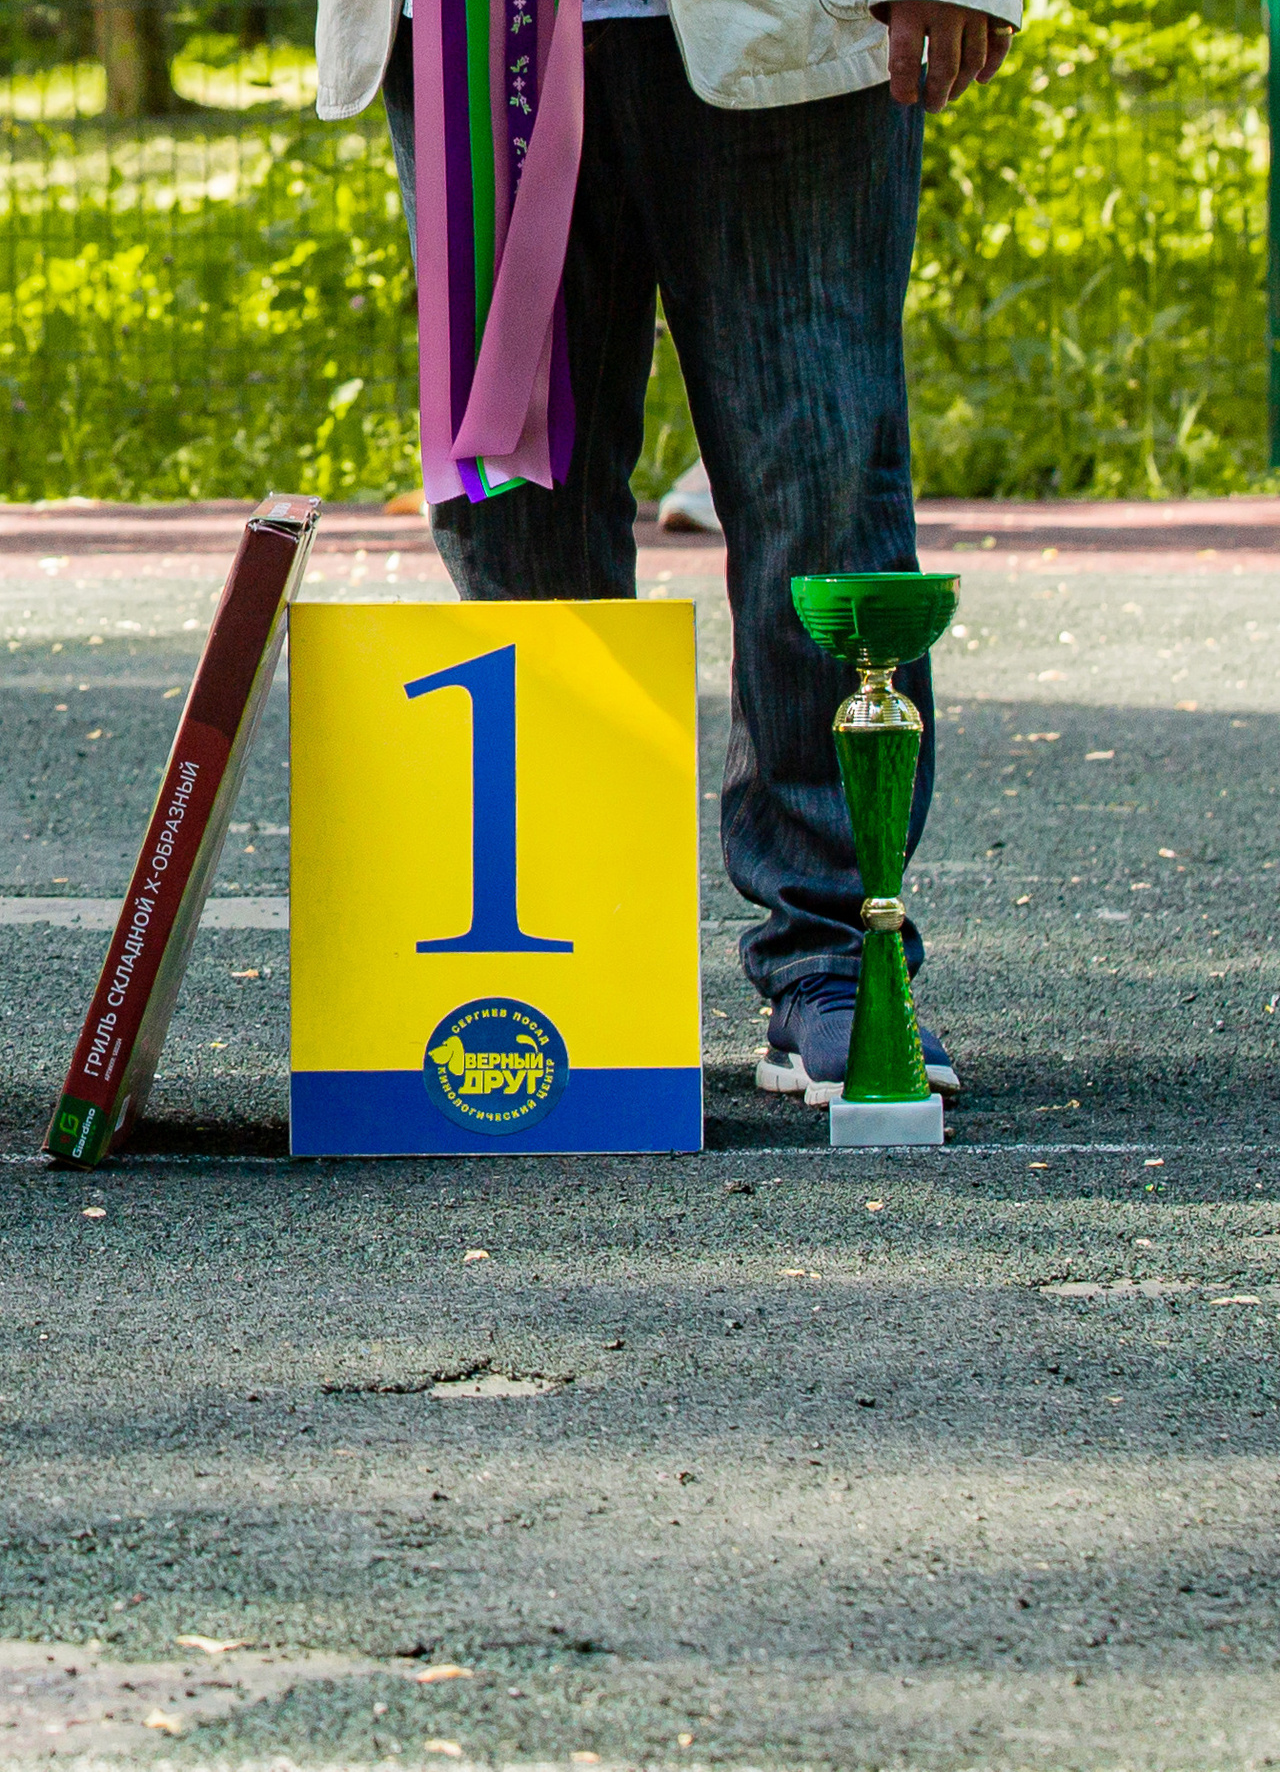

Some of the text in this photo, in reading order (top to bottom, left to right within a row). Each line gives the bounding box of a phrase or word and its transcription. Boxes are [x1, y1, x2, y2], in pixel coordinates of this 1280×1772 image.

[403, 643, 574, 954] 1
[83, 1012, 118, 1078] ГРИЛЬ
[107, 896, 156, 1007] СКЛАДНОЙ
[451, 1008, 550, 1046] СЕРГИЕВ ПОСАД
[458, 1069, 544, 1095] ДРУГ
[464, 1049, 544, 1069] ВЕРНЫЙ
[437, 1058, 555, 1122] КИНОЛОГИЧЕСКИЙ ЦЕНТР
[72, 1108, 96, 1159] Giardino
